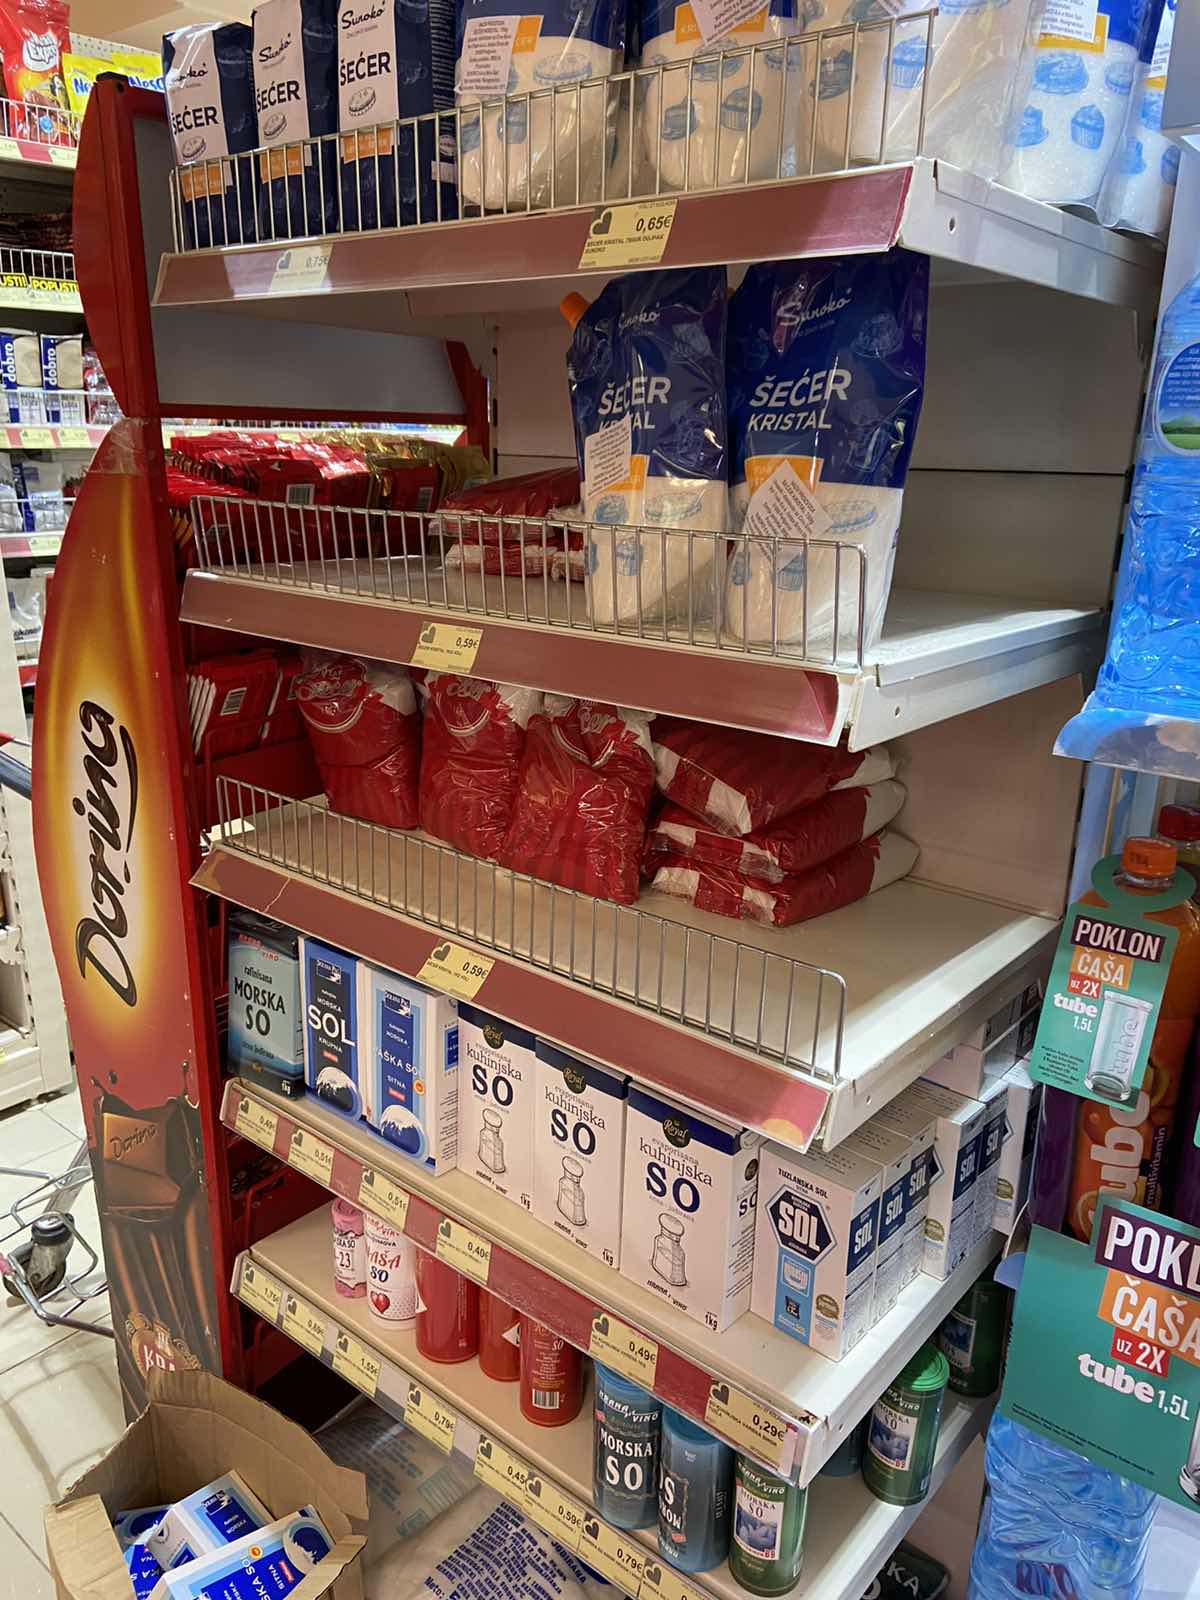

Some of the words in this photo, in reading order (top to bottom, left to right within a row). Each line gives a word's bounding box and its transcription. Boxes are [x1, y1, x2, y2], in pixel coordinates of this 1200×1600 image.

[340, 51, 391, 86] ŠEĆER
[256, 80, 301, 113] ŠEĆER
[636, 214, 673, 233] 0,65€
[2, 342, 16, 383] dobro
[43, 348, 58, 386] dobro
[750, 368, 852, 408] ŠEĆER
[748, 408, 832, 432] KRISTAL
[456, 637, 479, 649] 0,59€
[72, 700, 138, 1007] Dorina
[1074, 918, 1161, 961] POKLON
[462, 962, 489, 979] 0,59€
[1077, 946, 1125, 986] ČAŠA
[234, 976, 286, 1014] MORSKA
[1083, 980, 1100, 998] 2X
[317, 998, 342, 1012] MORSKA
[1053, 992, 1098, 1018] tube
[246, 1004, 271, 1036] SO
[308, 1004, 356, 1047] SOL
[319, 1037, 343, 1053] KRUPNA
[376, 1047, 404, 1070] AŠKA
[466, 1042, 522, 1081] kuhinjska
[387, 1075, 407, 1089] SITNA
[472, 1064, 514, 1107] SO
[544, 1086, 606, 1129] kuhinjska
[551, 1108, 596, 1156] SO
[663, 1119, 689, 1138] Royal
[1090, 1090, 1151, 1201] ub
[639, 1137, 713, 1188] kuhinjska
[1146, 1127, 1167, 1205] multivitamin
[646, 1161, 701, 1213] SO
[778, 1168, 814, 1192] TUZLANSKA
[815, 1186, 829, 1199] SOL
[909, 1164, 927, 1196] SOL
[885, 1192, 904, 1226] SOL
[777, 1200, 820, 1252] SOL
[854, 1219, 873, 1254] SOL
[467, 1241, 490, 1260] 0,40€
[602, 1249, 614, 1266] 1kg
[370, 1265, 389, 1283] SO
[705, 1313, 718, 1331] 1kg
[1111, 1274, 1200, 1360] ČAŠA
[551, 1339, 564, 1351] SO
[629, 1341, 656, 1365] 0,49€
[1136, 1343, 1166, 1374] 2X
[1078, 1353, 1155, 1403] tube
[1157, 1389, 1191, 1421] 1,5L
[632, 1413, 659, 1423] VINO
[899, 1402, 920, 1410] VINO
[434, 1412, 455, 1432] 0,79€
[753, 1414, 785, 1442] 0,29€
[600, 1427, 653, 1457] MORSKA
[507, 1465, 528, 1485] 0,45
[605, 1456, 644, 1491] SO
[741, 1489, 776, 1510] MORSKA
[763, 1486, 785, 1494] VINO
[558, 1505, 582, 1529] 0,59€
[660, 1504, 682, 1530] MOR
[749, 1504, 764, 1518] SO
[616, 1548, 643, 1573] 0,79€
[268, 1563, 286, 1590] SITNA
[425, 1576, 446, 1600] Neto:
